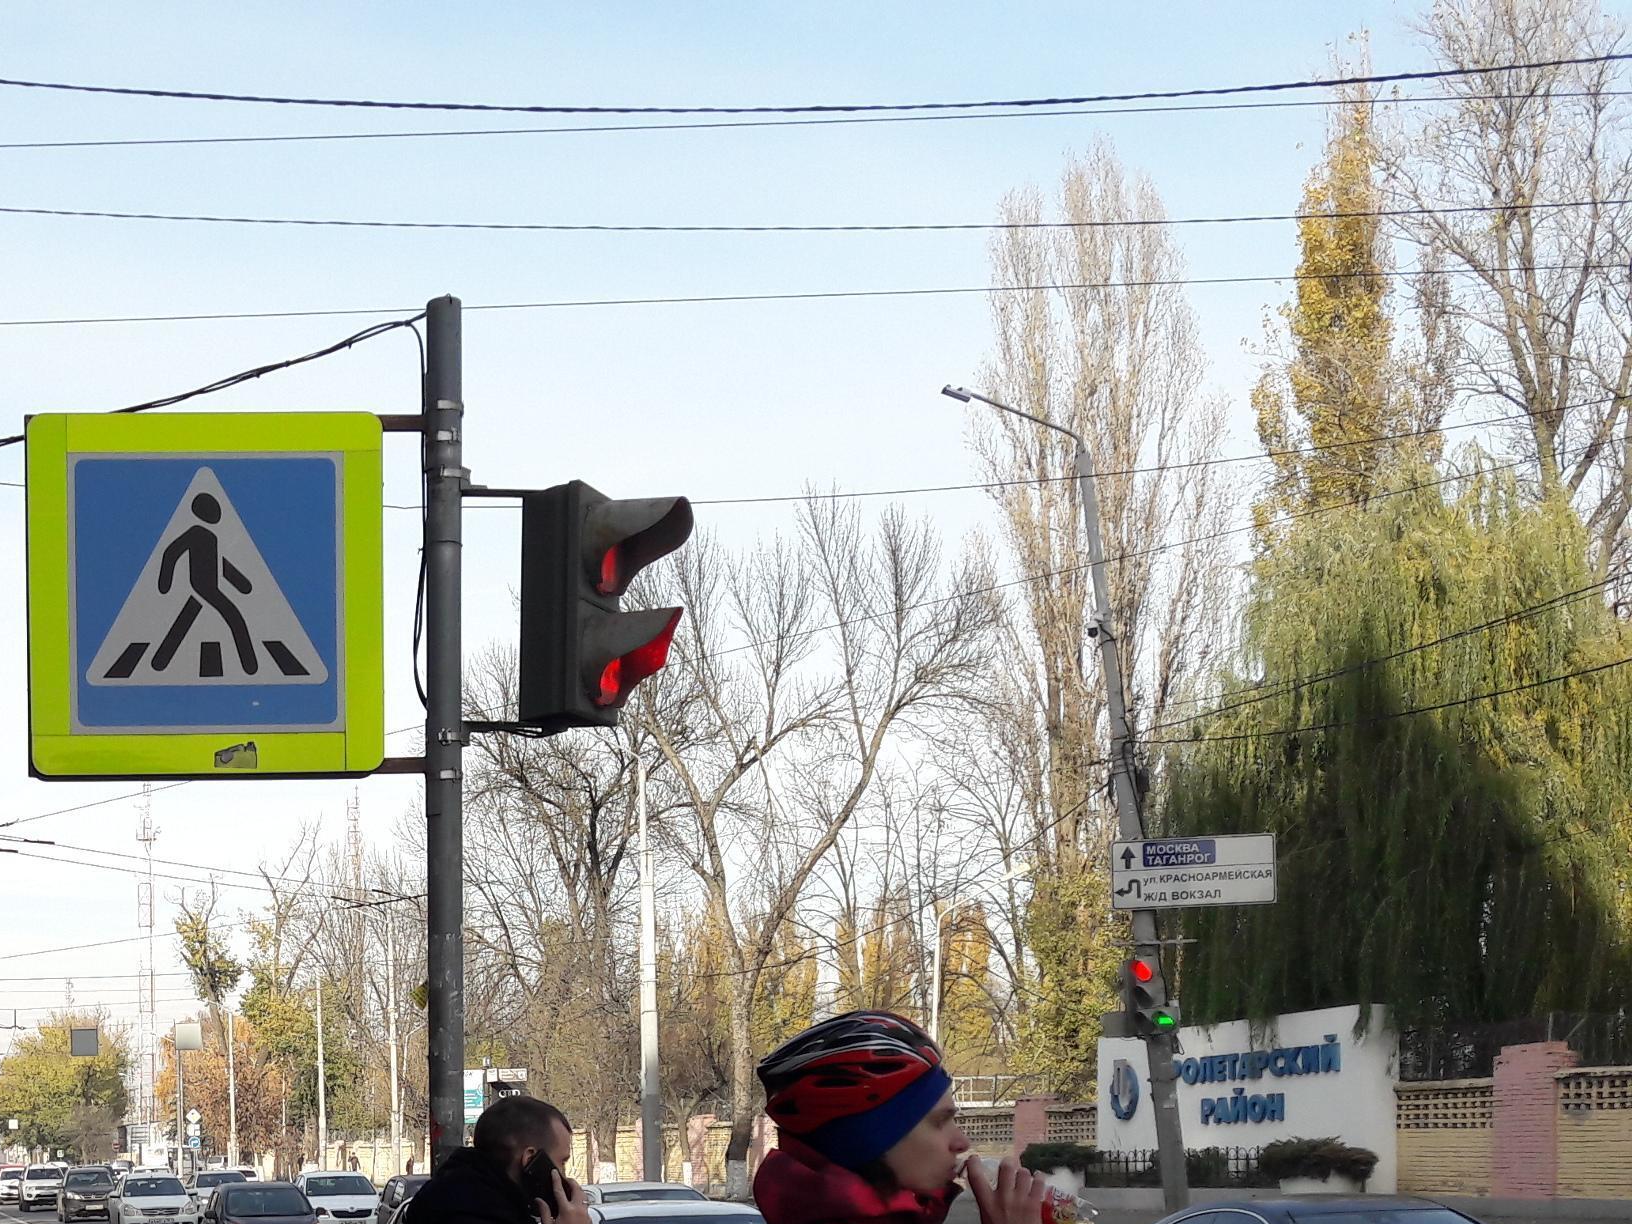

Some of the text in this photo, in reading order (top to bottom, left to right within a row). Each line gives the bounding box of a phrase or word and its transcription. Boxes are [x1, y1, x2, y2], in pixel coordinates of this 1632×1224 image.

[1146, 843, 1200, 855] МОСКВА
[1146, 852, 1211, 865] ТАГАНРОГ
[1159, 869, 1273, 883] КРАСНОАРМЕЙСКАЯ
[1143, 889, 1222, 903] Ж/Д ВОКЗАЛ
[1201, 1087, 1285, 1125] РАЙОН
